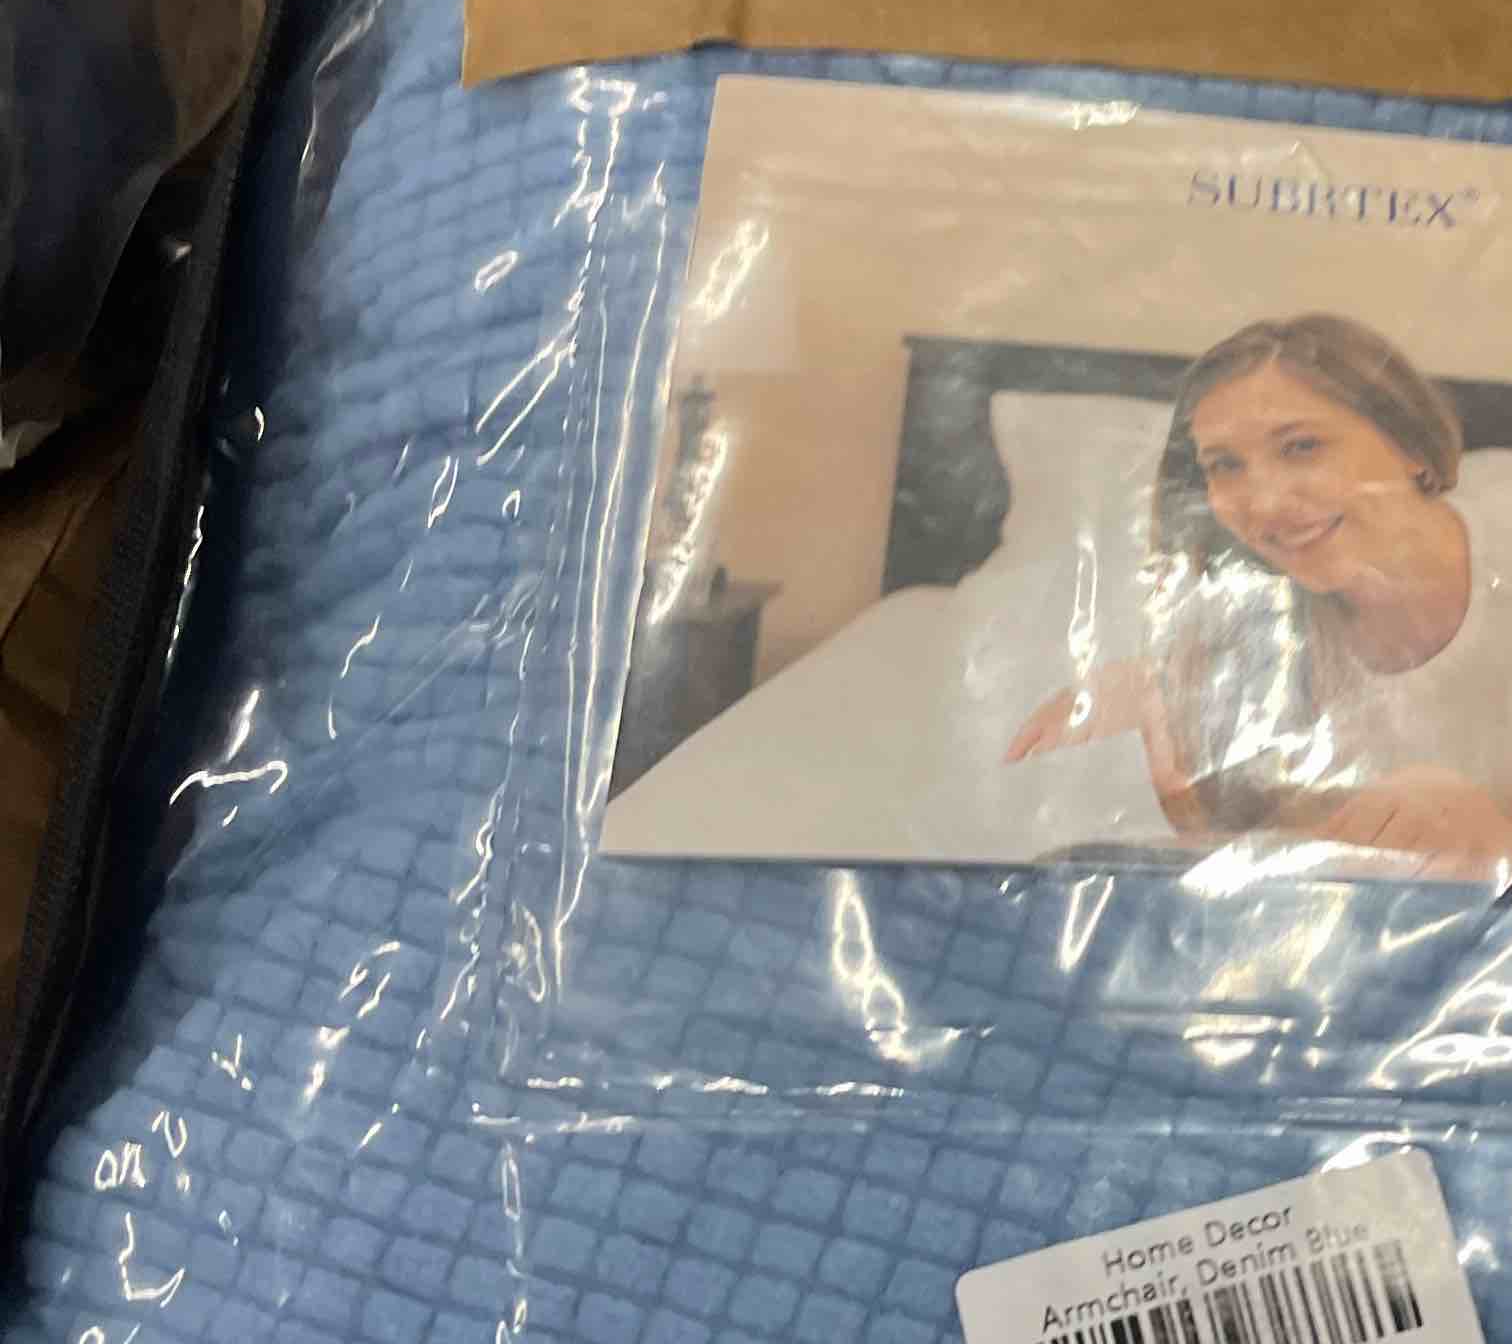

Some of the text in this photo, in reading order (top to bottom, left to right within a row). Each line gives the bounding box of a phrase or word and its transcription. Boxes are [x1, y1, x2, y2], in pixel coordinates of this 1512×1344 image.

[1041, 1220, 1370, 1333] Armchair, Denim Blue
[1103, 1204, 1294, 1279] Home Decor
